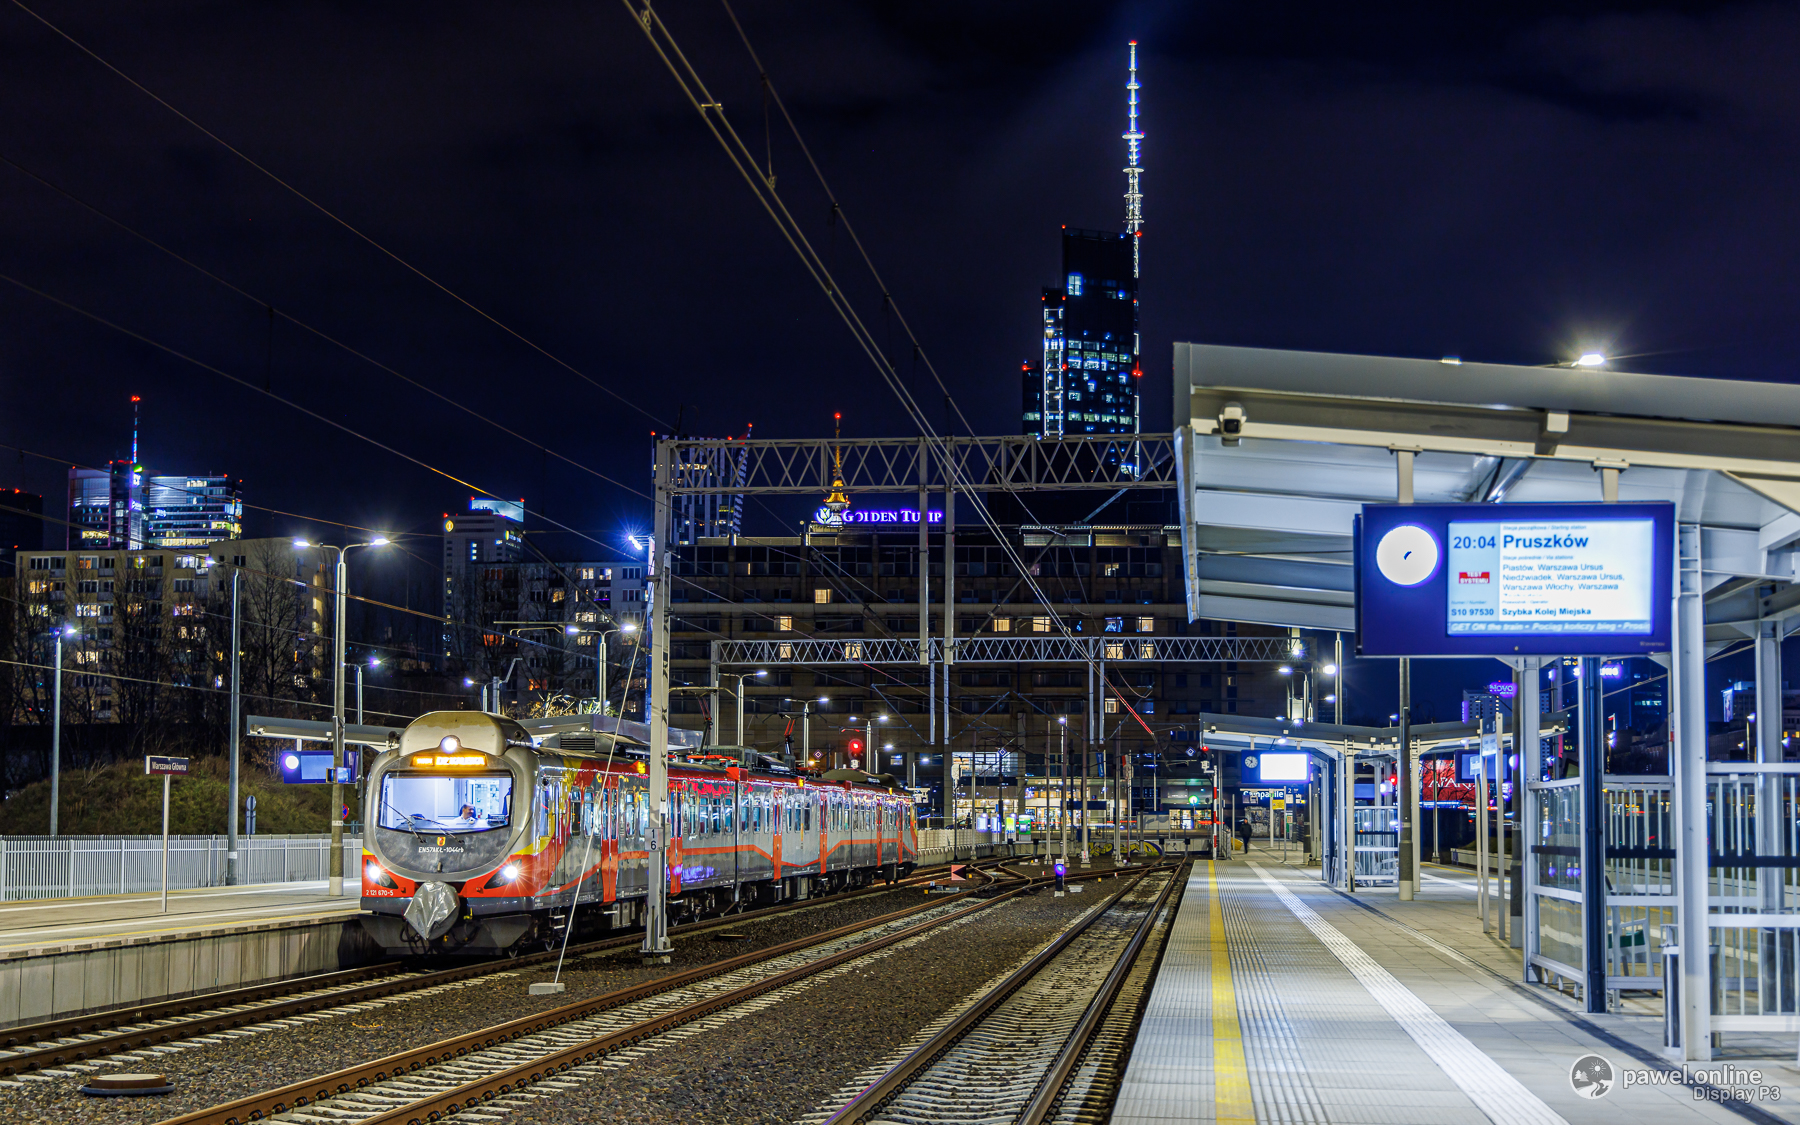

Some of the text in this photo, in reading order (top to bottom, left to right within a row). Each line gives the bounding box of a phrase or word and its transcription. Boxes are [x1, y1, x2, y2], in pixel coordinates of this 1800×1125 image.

[900, 510, 942, 522] TUIP
[1453, 536, 1496, 548] 20:04
[1504, 534, 1589, 548] Pruszków
[1535, 608, 1556, 616] Kolej
[1559, 608, 1591, 616] Miejska
[152, 762, 186, 770] Warszawa Główna
[652, 829, 654, 838] 1
[651, 841, 656, 850] 6
